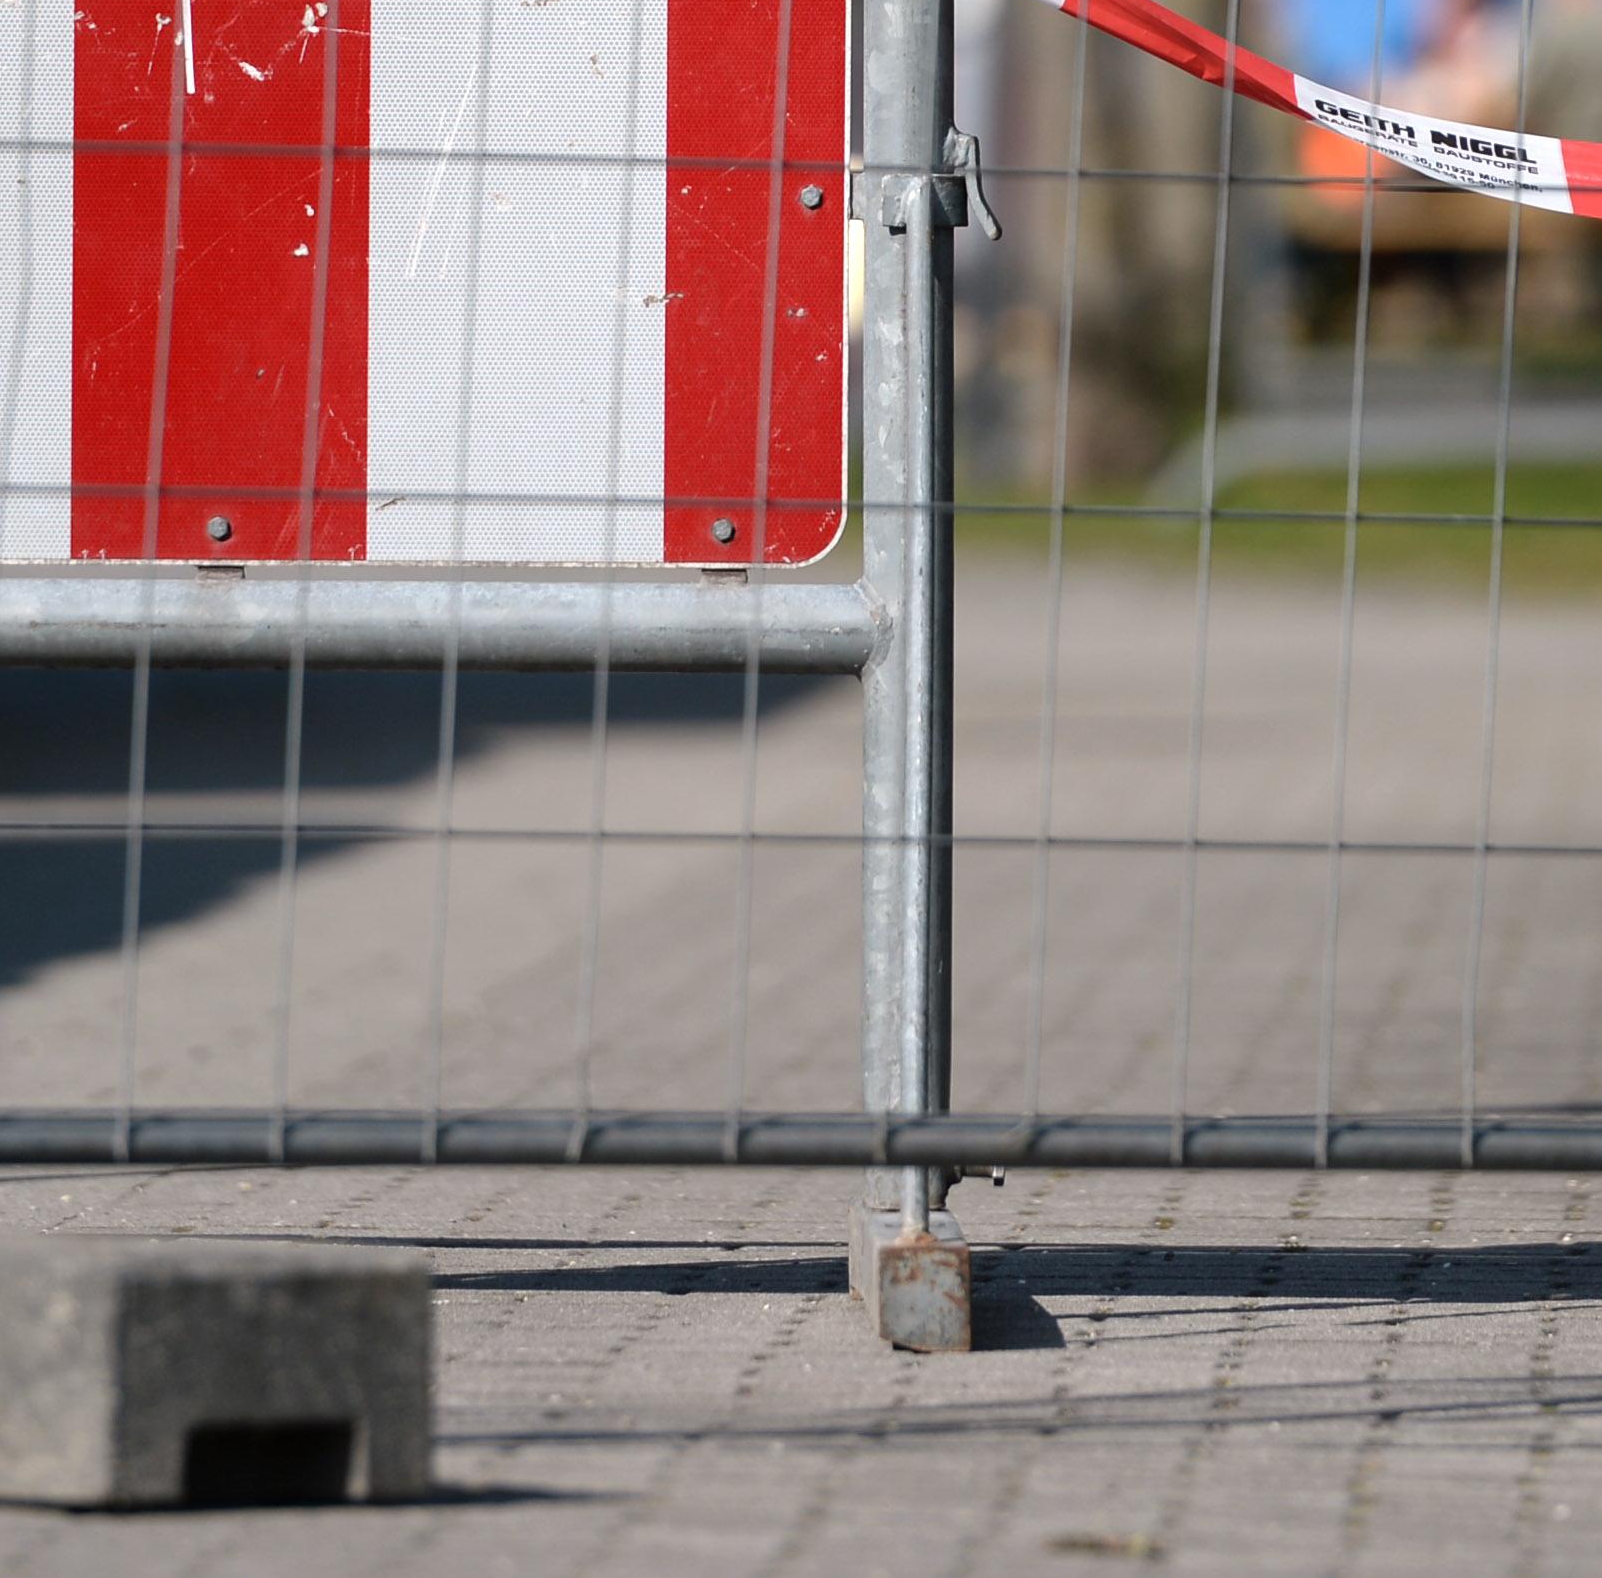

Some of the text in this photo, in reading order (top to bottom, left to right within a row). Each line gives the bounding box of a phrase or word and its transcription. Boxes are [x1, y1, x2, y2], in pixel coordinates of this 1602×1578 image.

[1315, 98, 1416, 139] GEITH
[1430, 129, 1538, 164] NIGGL
[1433, 146, 1540, 175] BAUSTOFFE
